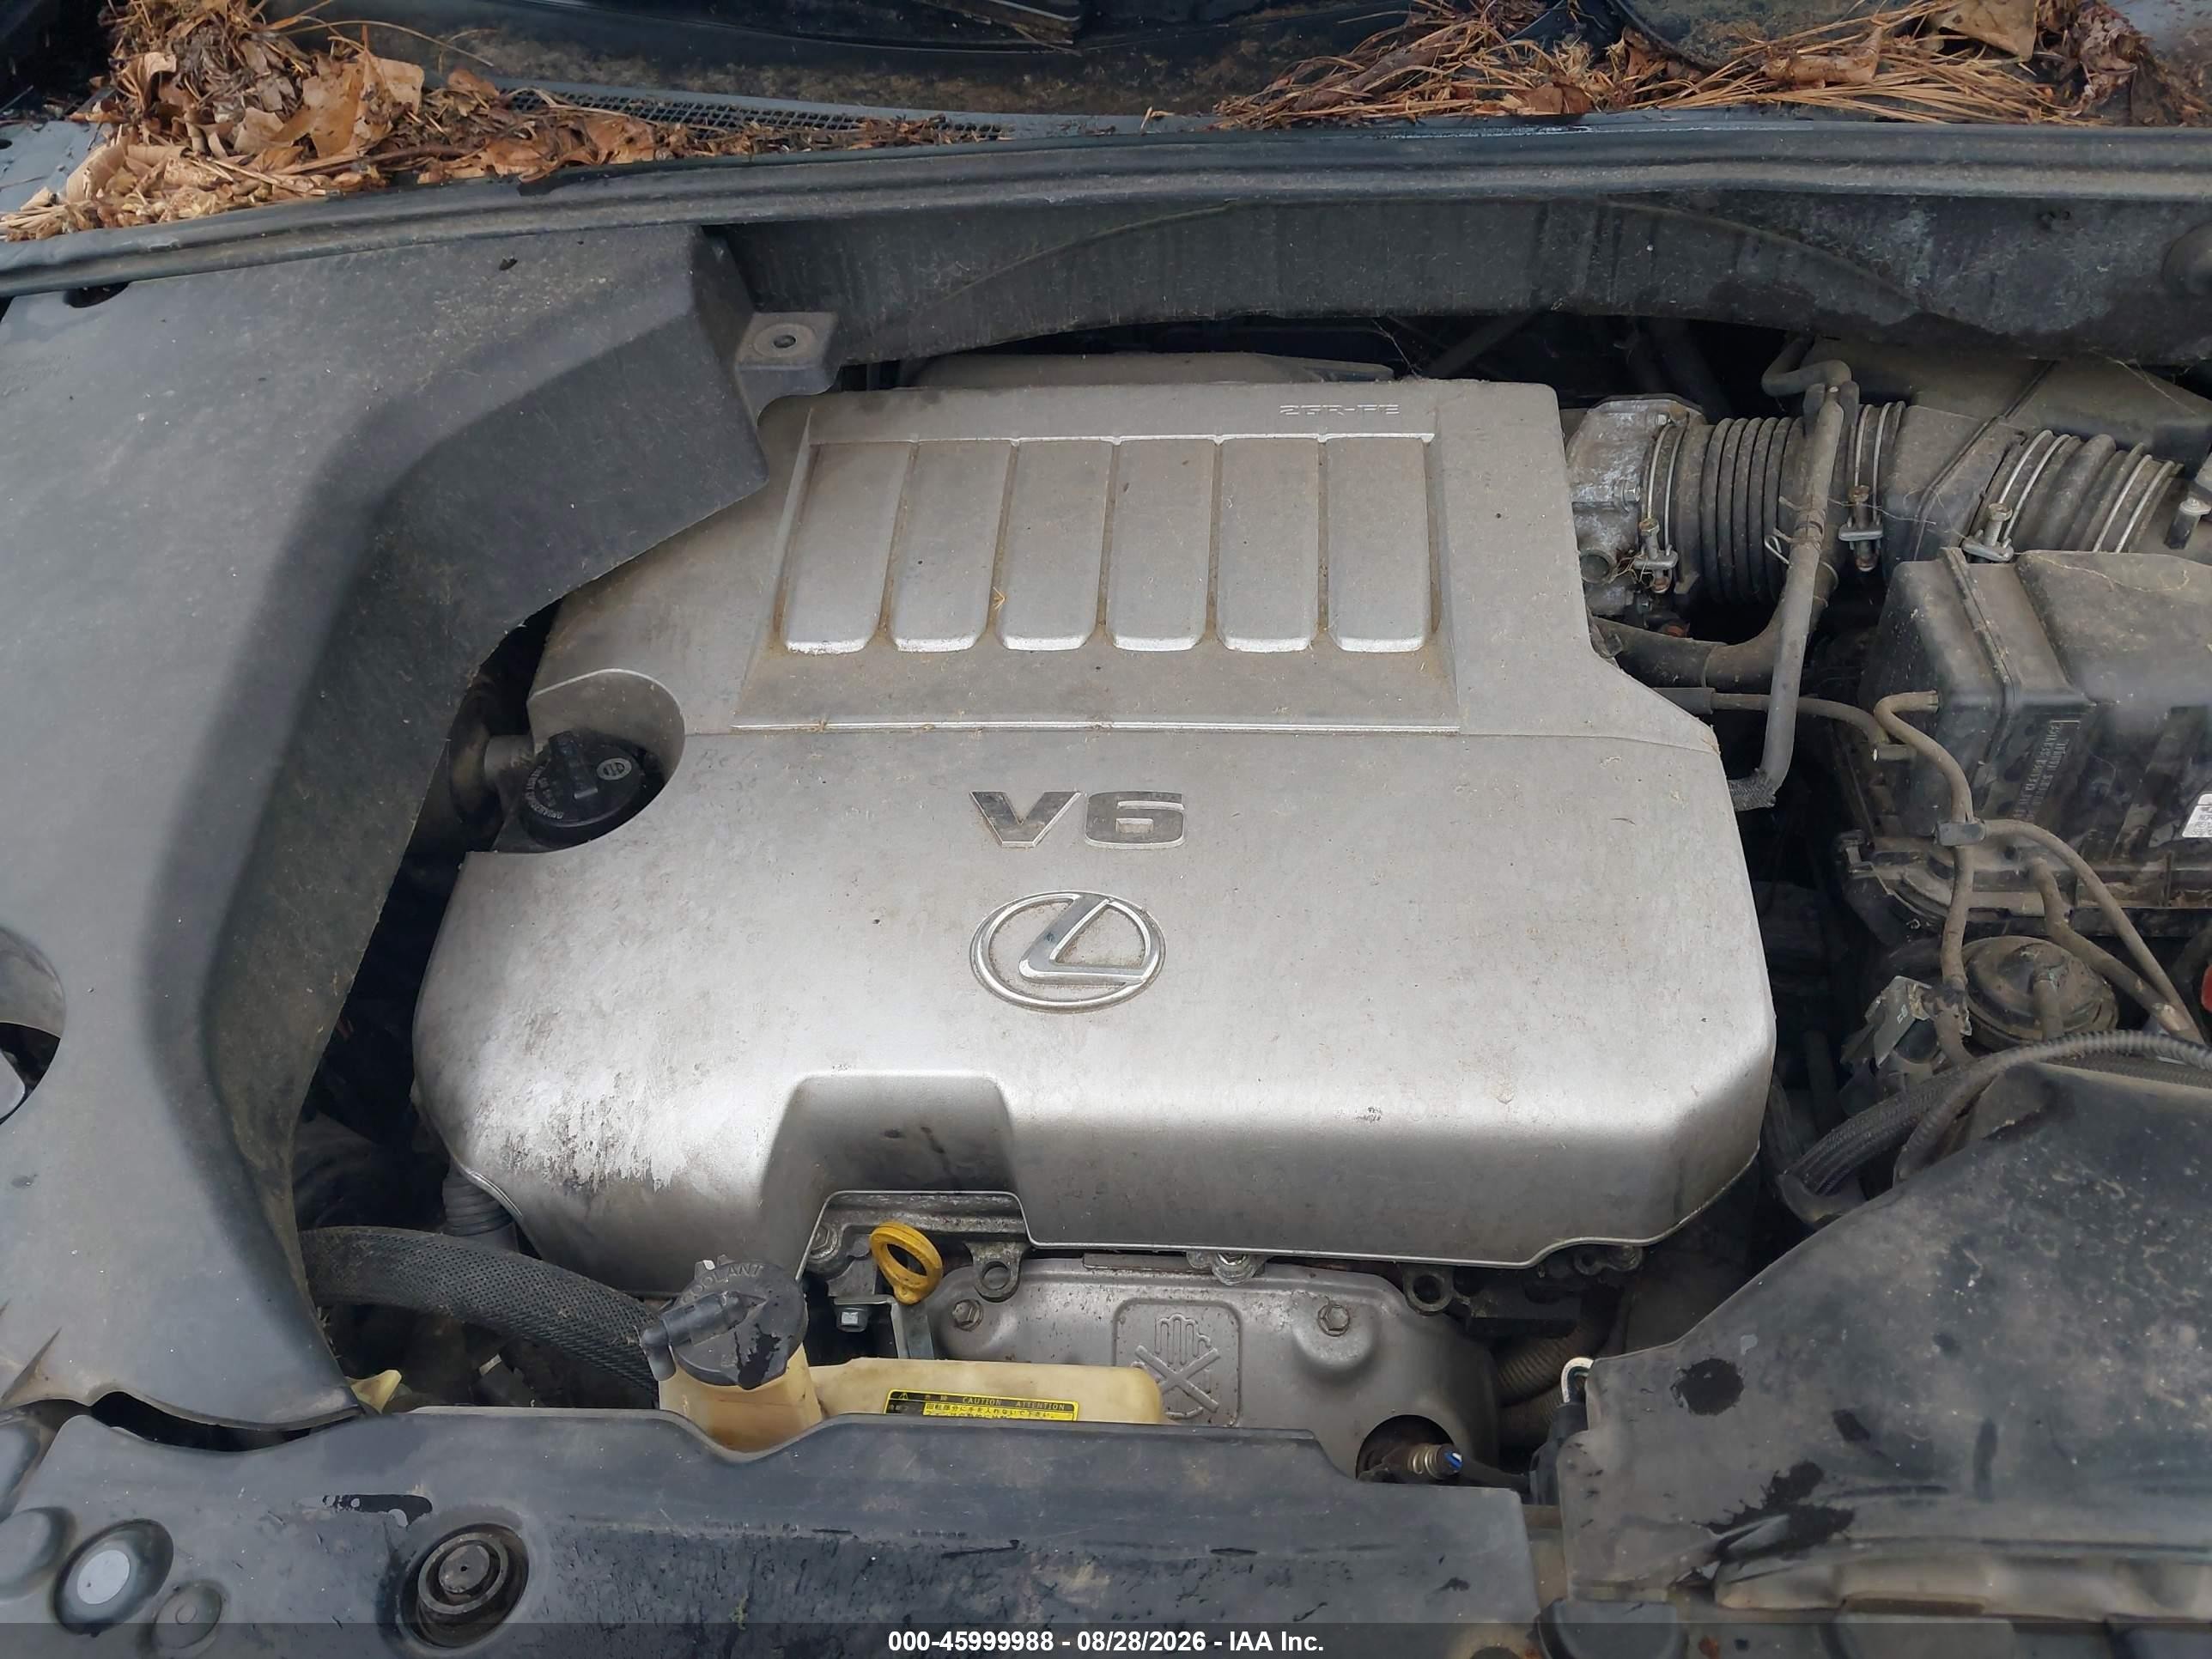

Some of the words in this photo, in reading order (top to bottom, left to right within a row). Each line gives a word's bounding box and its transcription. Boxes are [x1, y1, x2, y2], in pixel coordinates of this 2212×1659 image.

[968, 789, 1186, 850] V6
[681, 1263, 764, 1304] COOLANT
[961, 1396, 1004, 1406] CAUTION
[1014, 1401, 1066, 1411] ATTENTION
